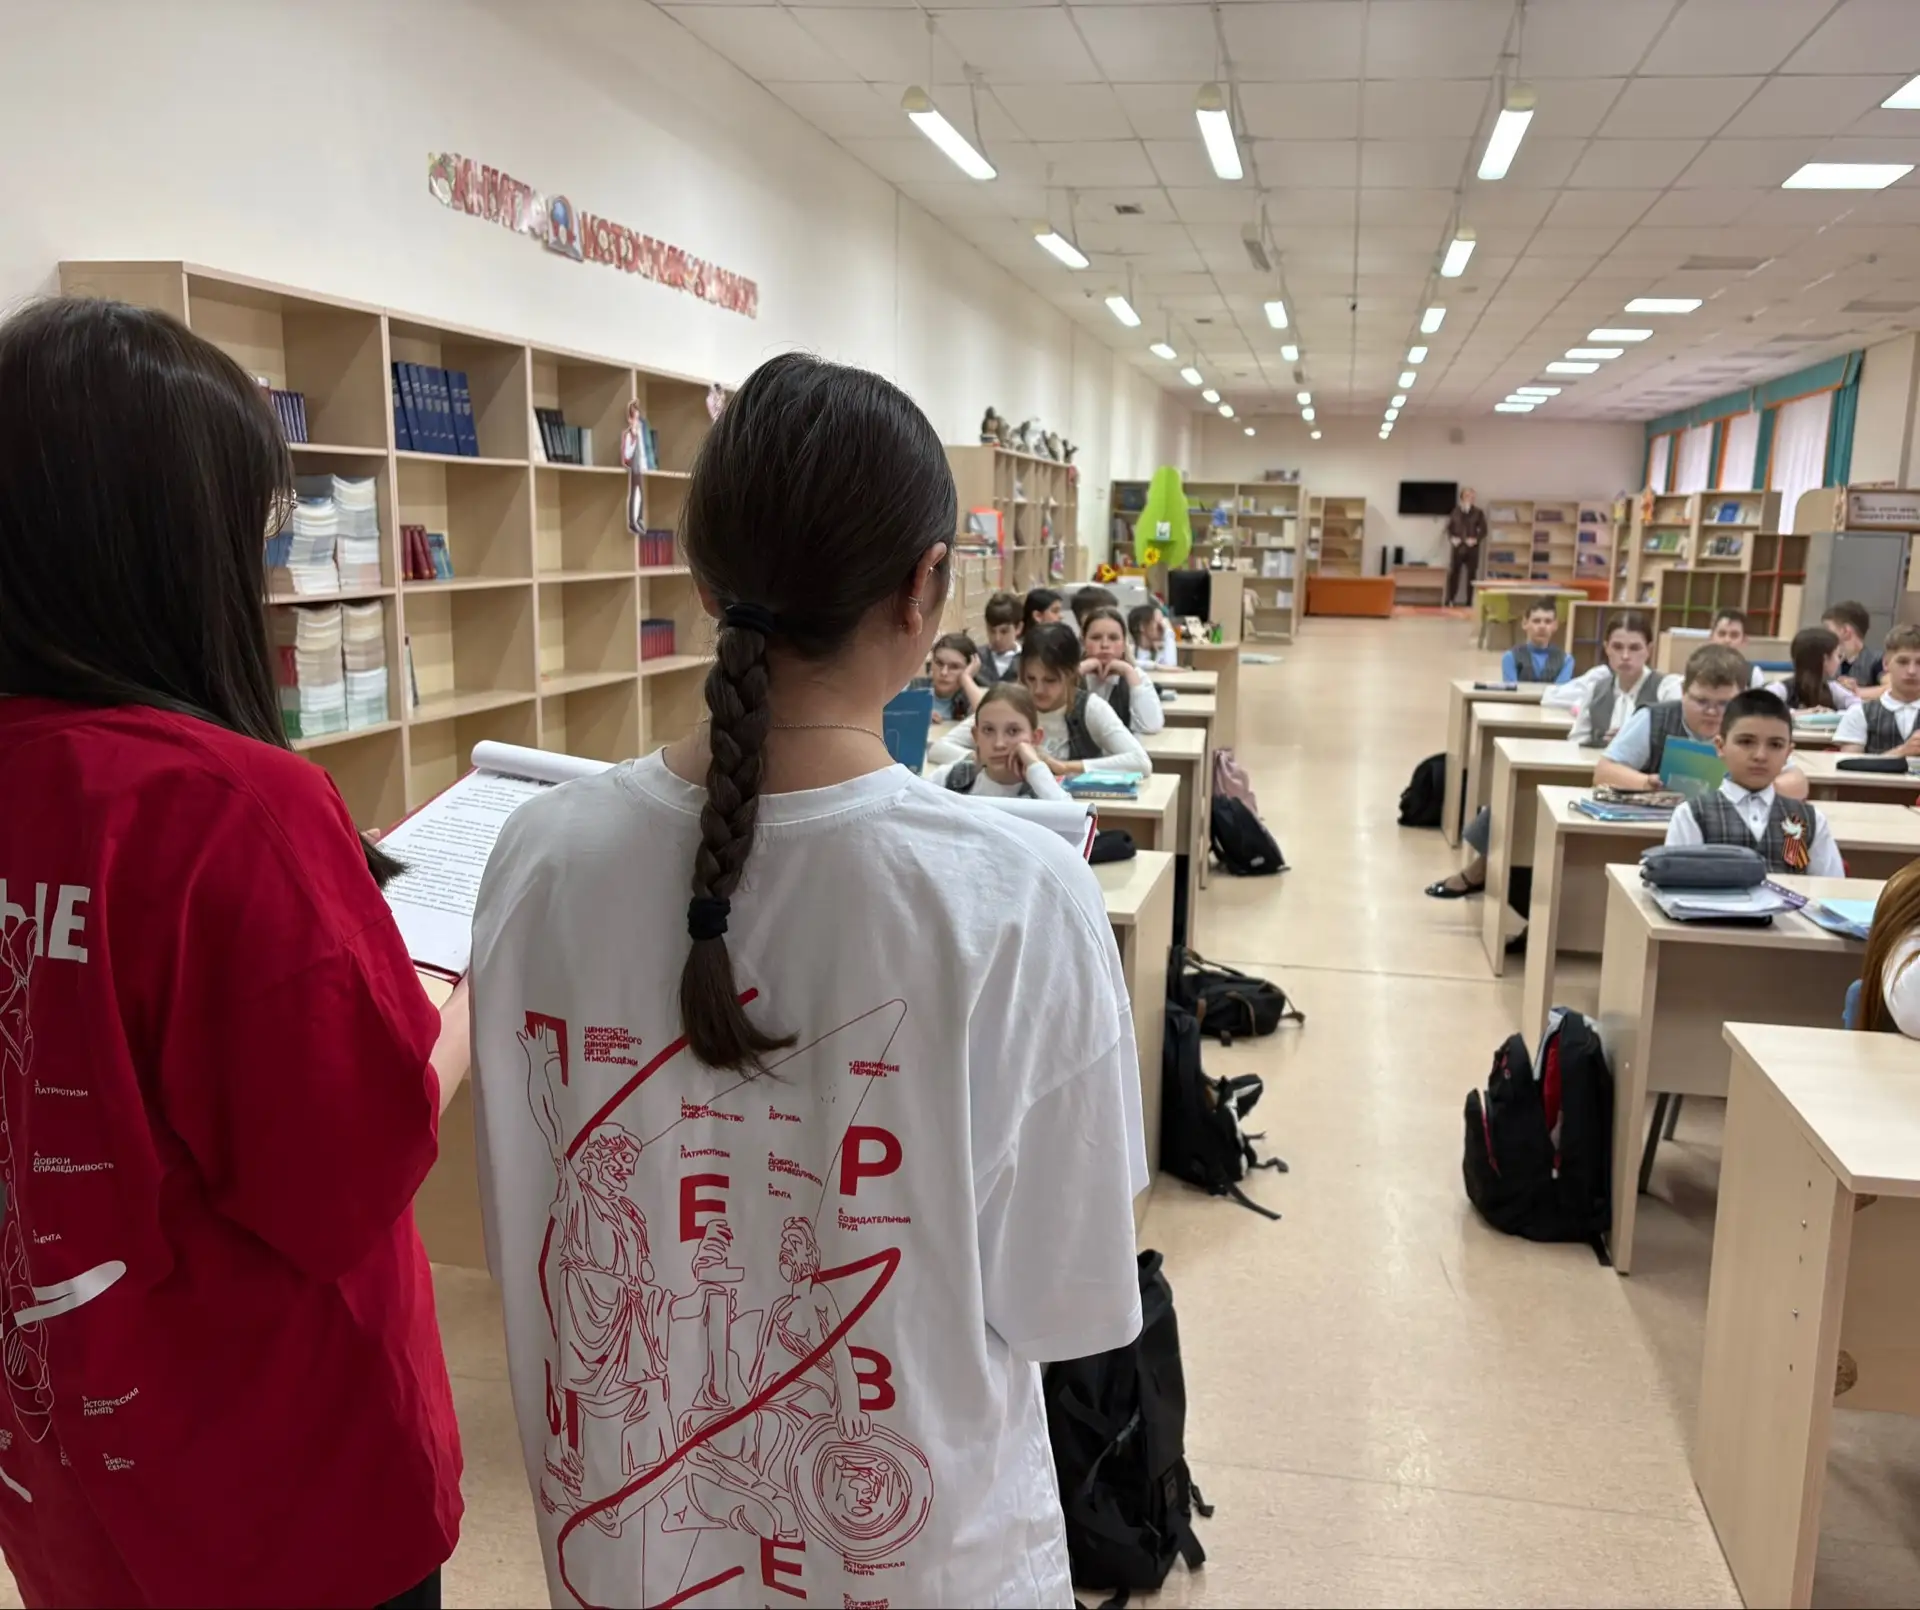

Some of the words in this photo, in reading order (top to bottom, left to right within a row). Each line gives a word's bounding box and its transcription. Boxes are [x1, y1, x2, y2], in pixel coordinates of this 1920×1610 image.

[584, 1026, 628, 1035] ЦЕННОСТИ
[584, 1032, 642, 1045] РОССИЙСКОГО
[584, 1041, 630, 1050] ДВИЖЕНИЯ
[584, 1048, 611, 1056] ДЕТЕЙ
[35, 1087, 88, 1096] ПАТРИОТИЗМ
[769, 1112, 802, 1123] ДРУЖБА
[681, 1148, 730, 1159] ПАТРИОТИЗМ
[34, 1158, 62, 1166] ДОБРО
[769, 1158, 793, 1167] ДОБРО
[33, 1163, 114, 1173] СПРАВЕДЛИВОСТЬ
[680, 1173, 729, 1242] Е
[840, 1126, 902, 1196] Р
[769, 1190, 791, 1200] МЕЧТА
[838, 1215, 911, 1225] СОЗИДАТЕЛЬНЫЙ
[838, 1221, 858, 1231] ТРУД
[84, 1407, 113, 1416] ПАМЯТЬ
[761, 1536, 807, 1600] Е
[843, 1566, 875, 1576] ПАМЯТЬ
